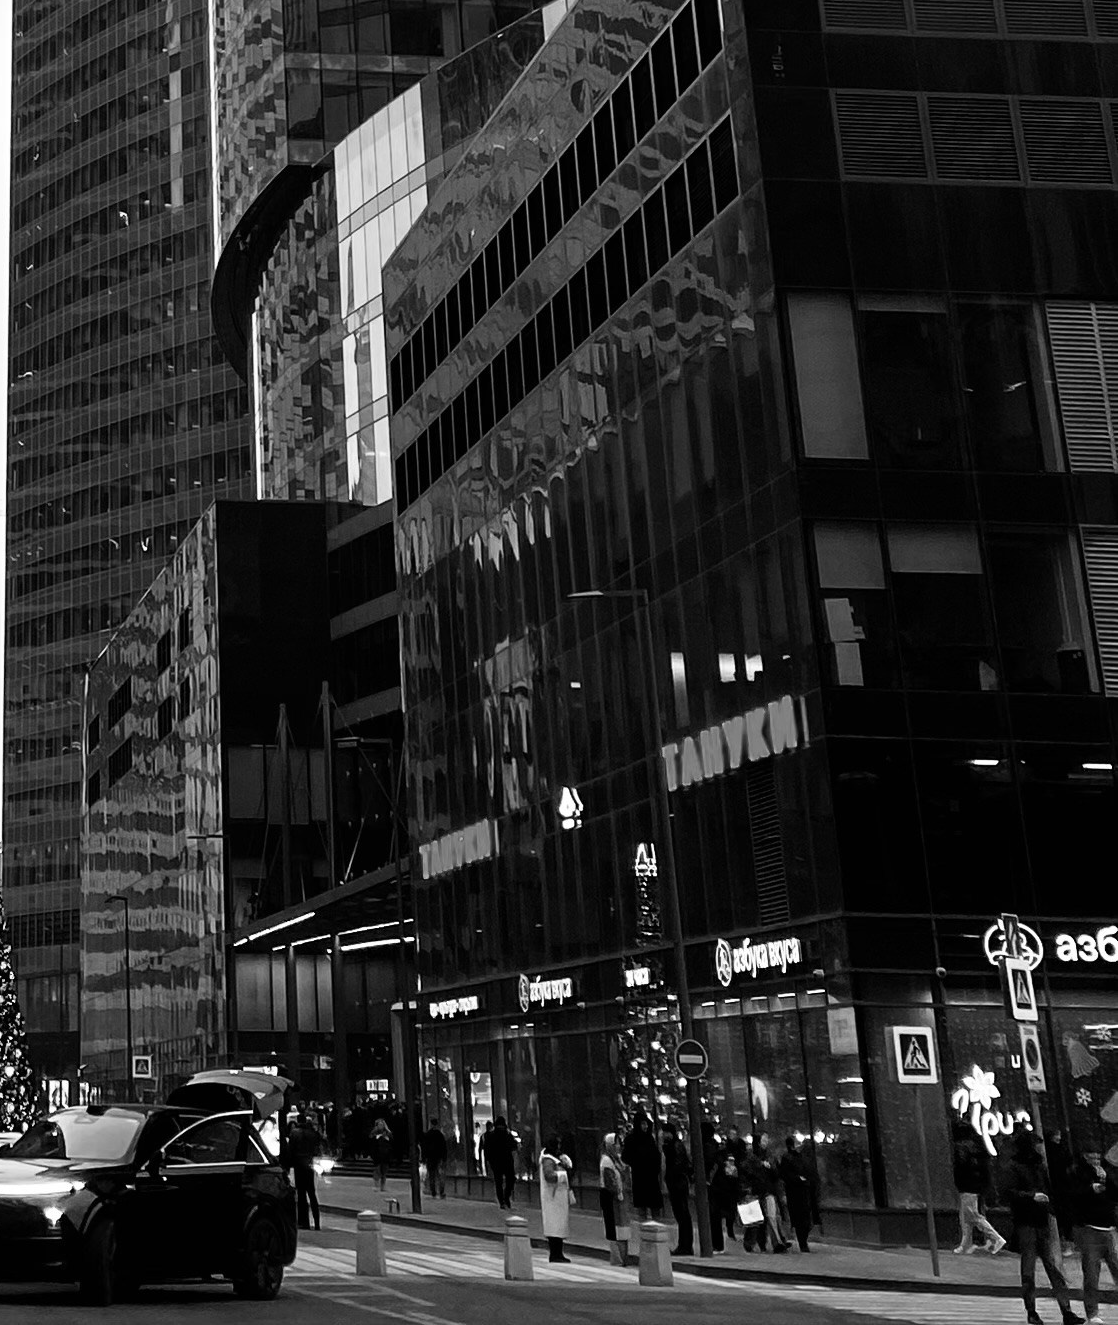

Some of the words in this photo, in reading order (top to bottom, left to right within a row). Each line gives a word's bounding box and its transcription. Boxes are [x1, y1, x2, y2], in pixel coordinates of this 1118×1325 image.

[662, 694, 798, 792] ТАНУКИ
[419, 817, 491, 880] ТАНУКИ
[733, 938, 769, 979] азбука
[768, 937, 802, 974] вкуса
[1055, 925, 1118, 962] азб
